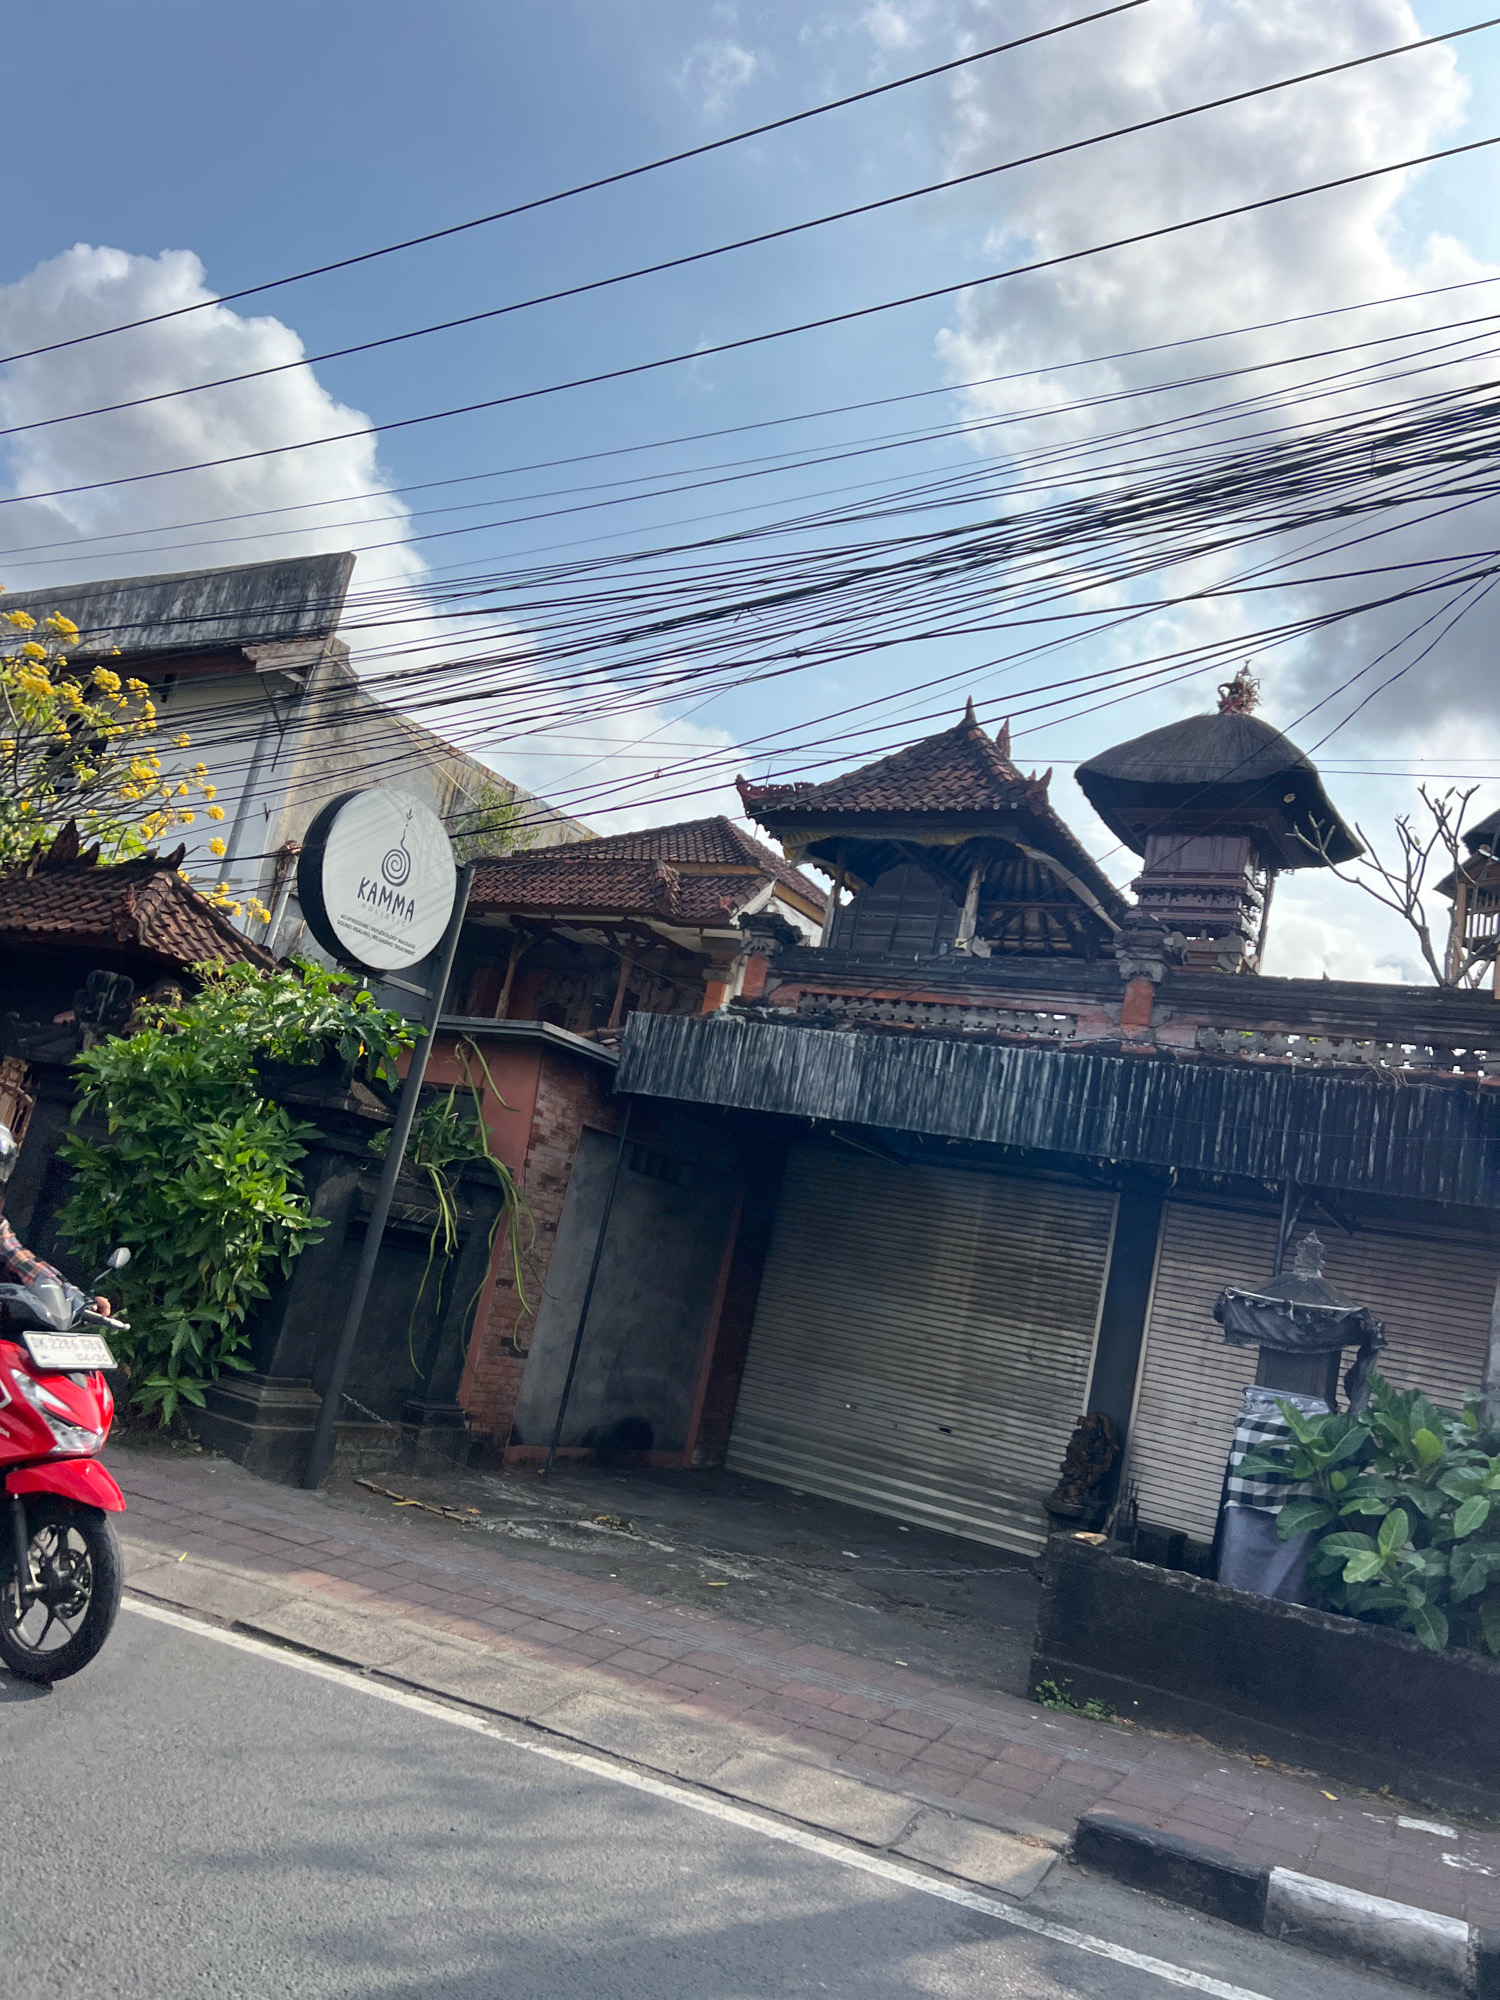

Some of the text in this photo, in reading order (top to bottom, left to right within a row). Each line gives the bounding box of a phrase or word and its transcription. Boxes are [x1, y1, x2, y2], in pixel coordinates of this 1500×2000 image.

[357, 876, 415, 923] KAMMA
[361, 903, 406, 927] HOLISTIC
[337, 919, 416, 956] SOUND HEALING RELEASING TREATMENT
[340, 914, 416, 949] ACUPRESSURE REFLEXOLOGY MASSAGE
